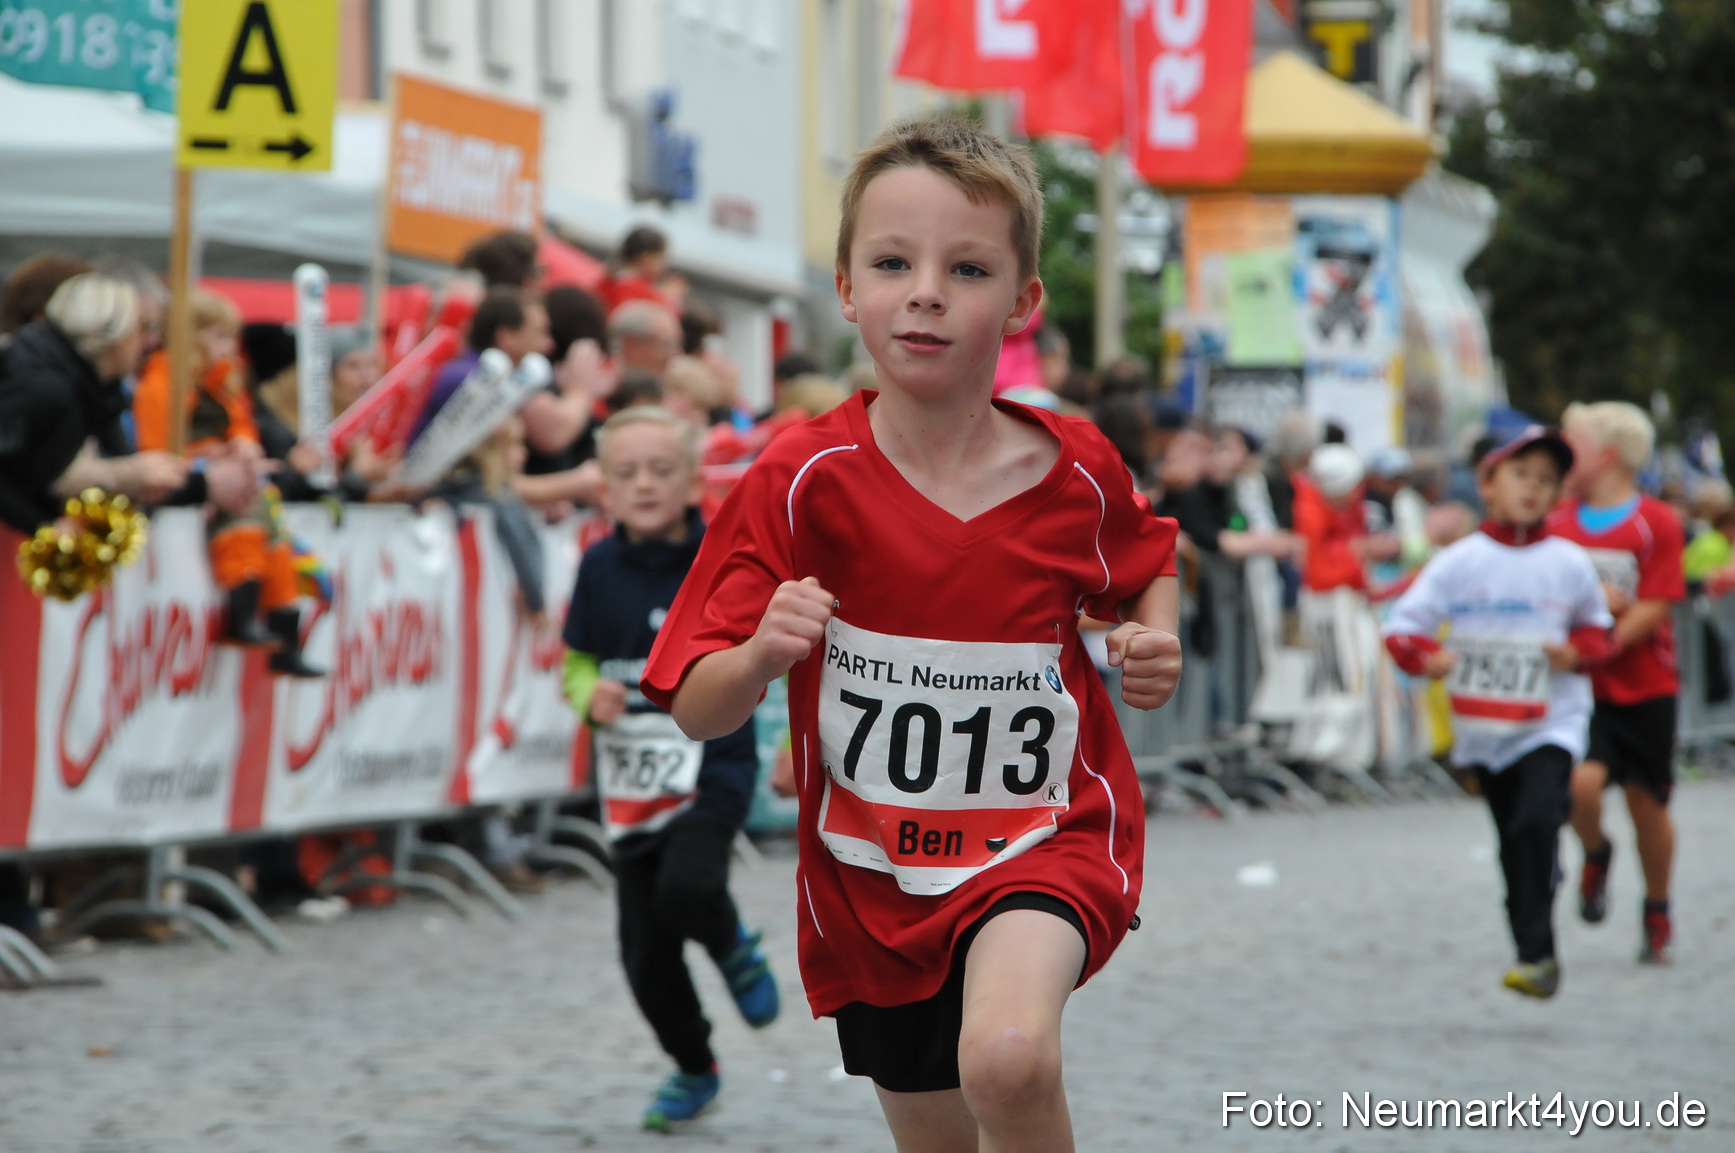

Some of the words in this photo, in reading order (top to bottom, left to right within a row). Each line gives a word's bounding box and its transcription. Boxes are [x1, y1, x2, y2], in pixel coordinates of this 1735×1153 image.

[213, 0, 298, 114] A
[827, 643, 902, 685] PARTL
[911, 665, 1041, 692] Neumarkt
[840, 688, 1055, 795] 7013
[1048, 785, 1057, 801] K
[898, 820, 963, 857] Ben
